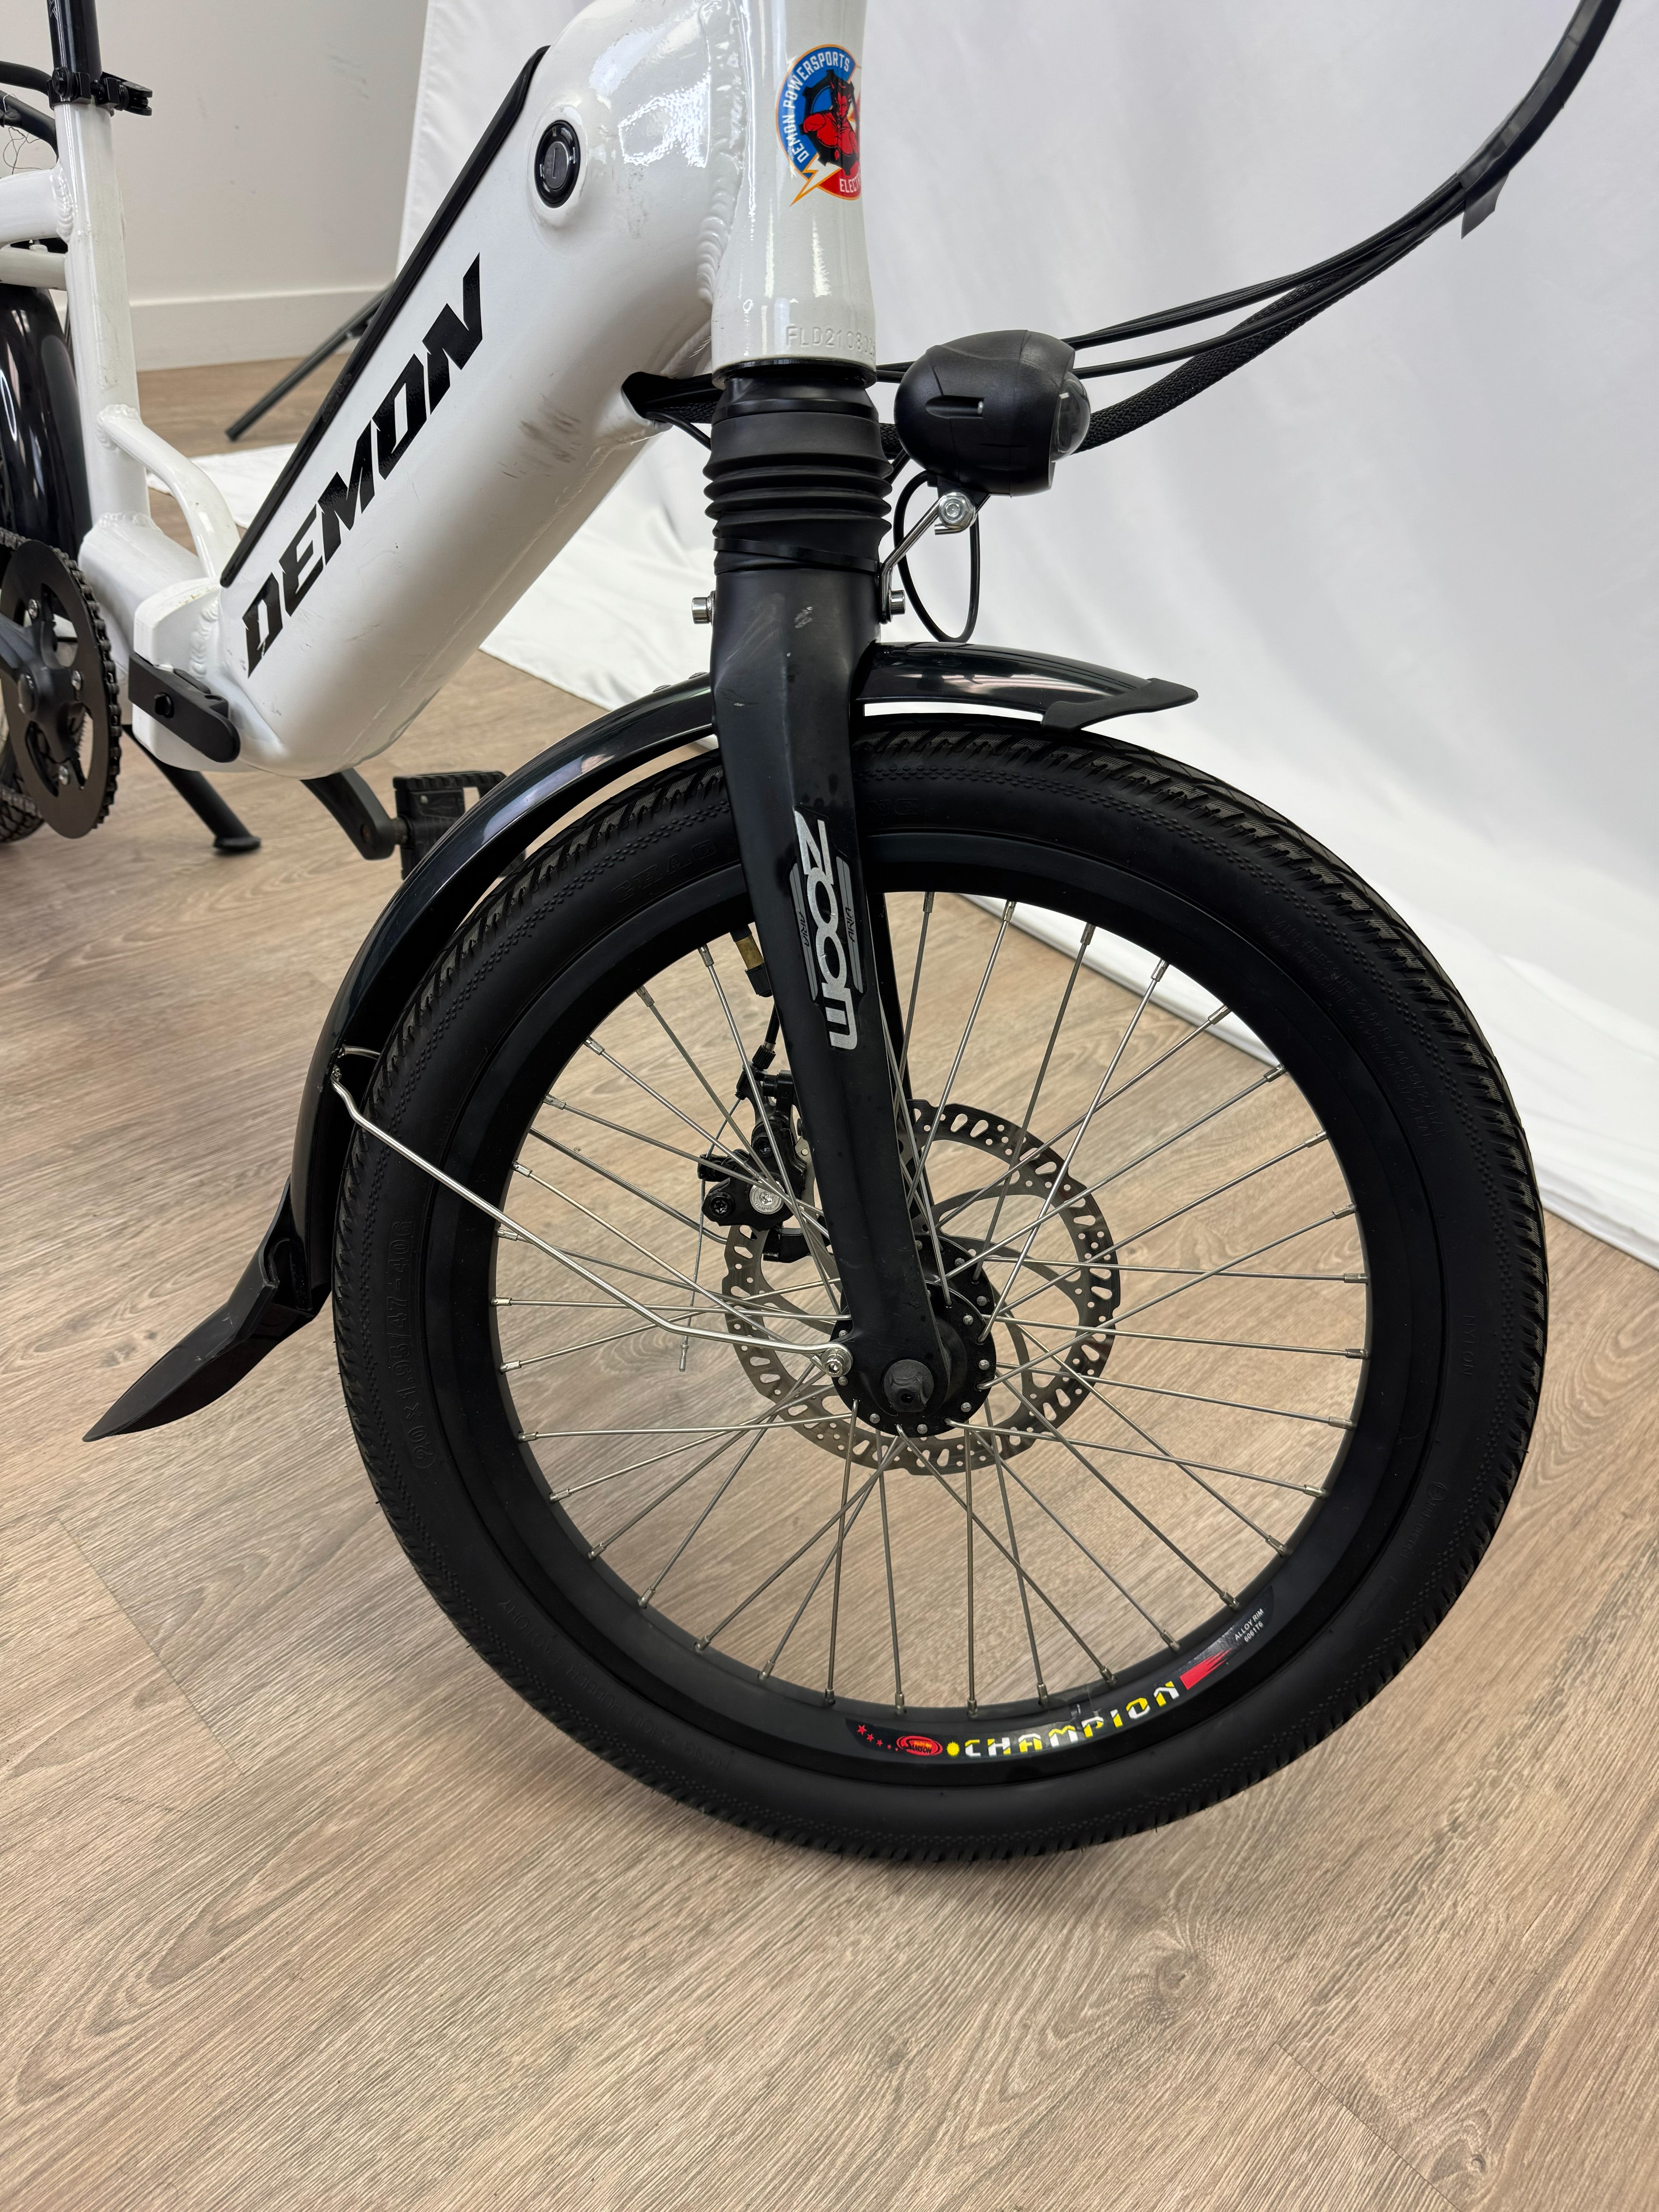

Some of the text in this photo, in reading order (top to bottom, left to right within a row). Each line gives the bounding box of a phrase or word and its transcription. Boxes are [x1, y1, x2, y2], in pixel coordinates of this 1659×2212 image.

[783, 51, 850, 163] DEMON POWERSPORTS
[839, 175, 859, 193] ELECT
[242, 252, 483, 678] DEMON
[1235, 1608, 1264, 1642] ALLOY RIM
[1244, 1621, 1263, 1642] 6061T6
[965, 1681, 1180, 1757] CHAMPION
